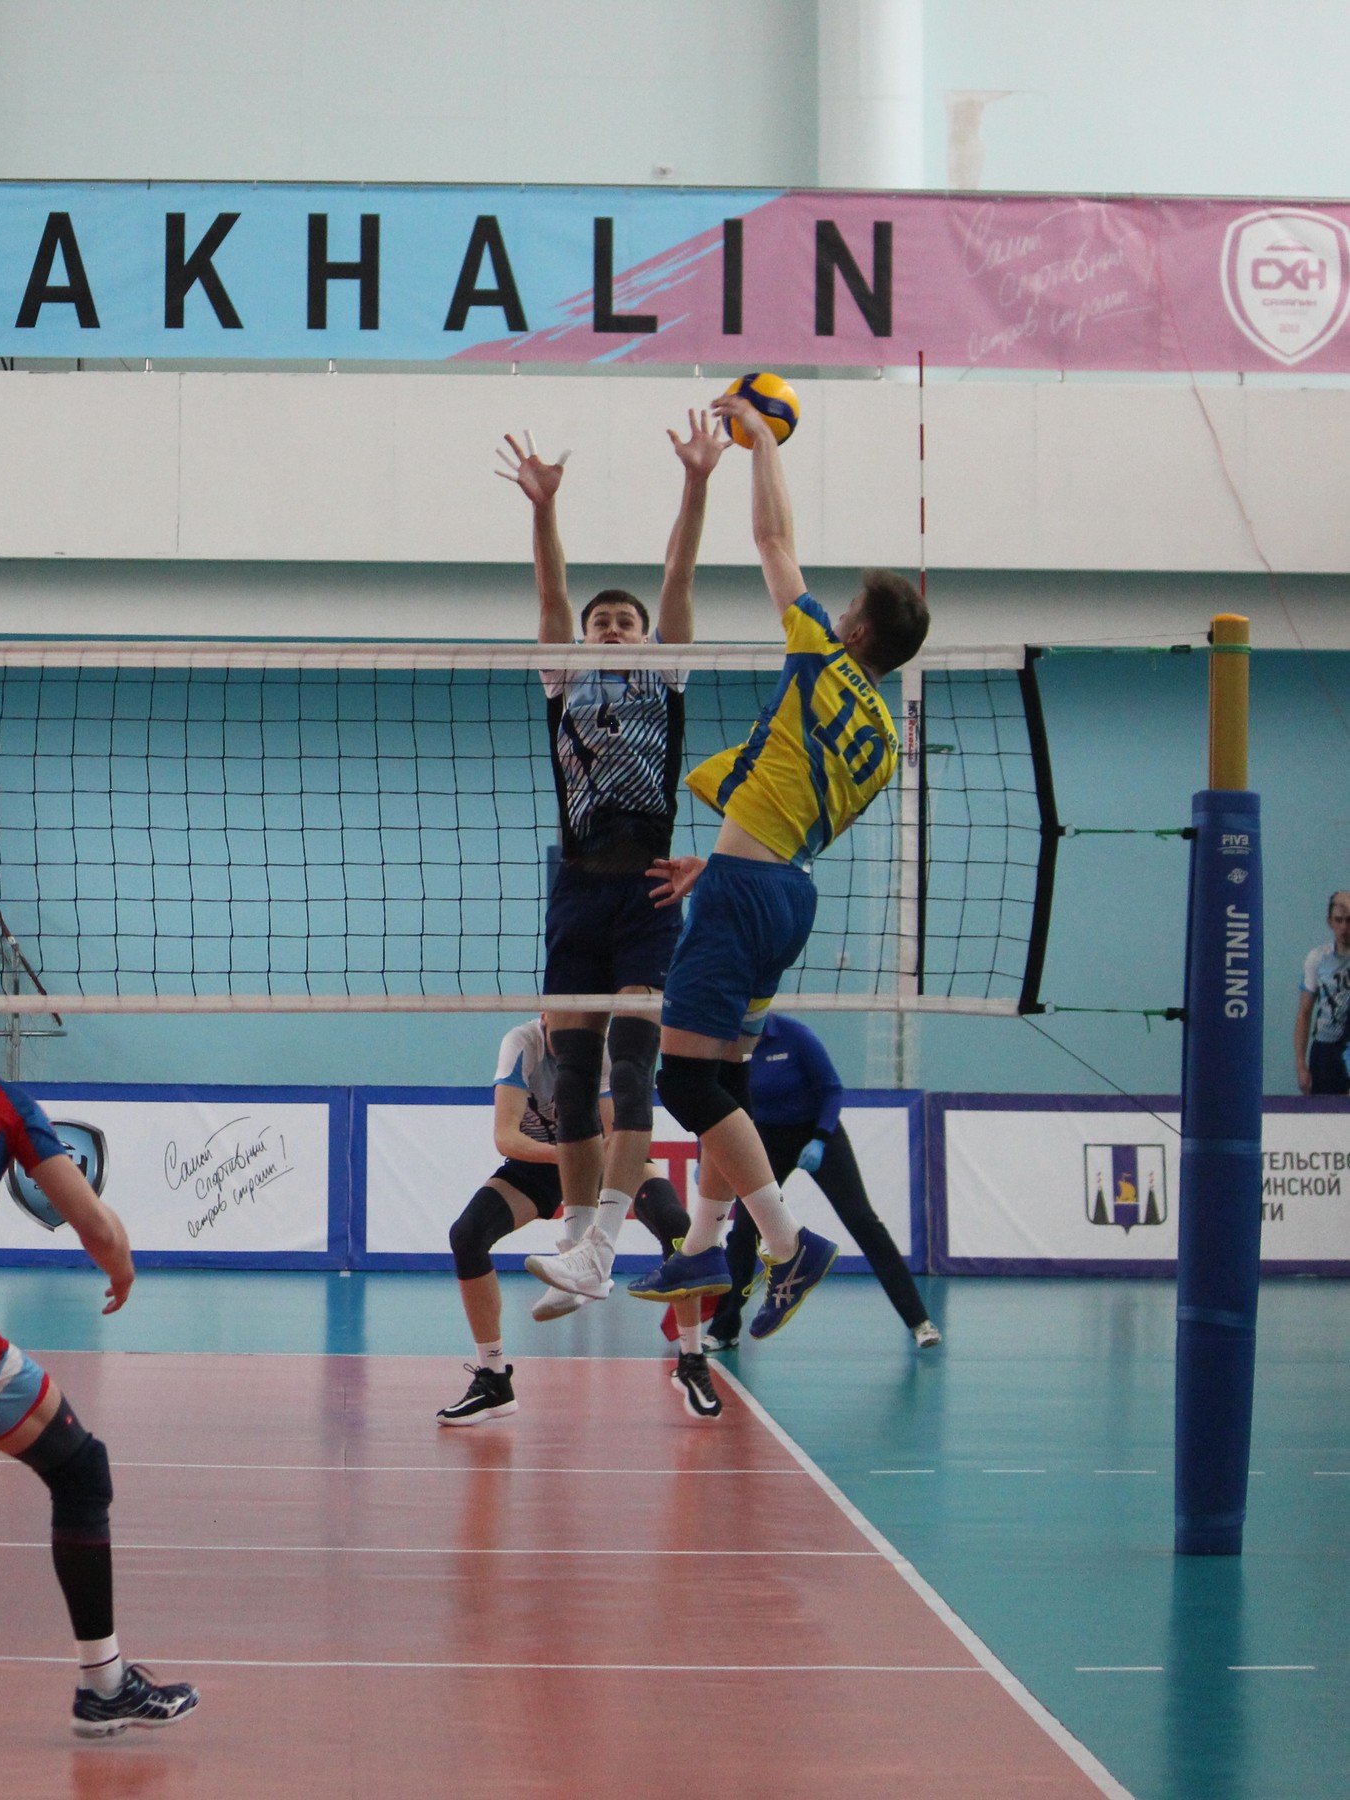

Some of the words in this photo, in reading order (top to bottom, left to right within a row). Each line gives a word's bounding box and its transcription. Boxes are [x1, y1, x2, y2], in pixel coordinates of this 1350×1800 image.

[596, 701, 621, 735] 4
[811, 687, 886, 786] 10
[1224, 904, 1249, 1019] JINLING
